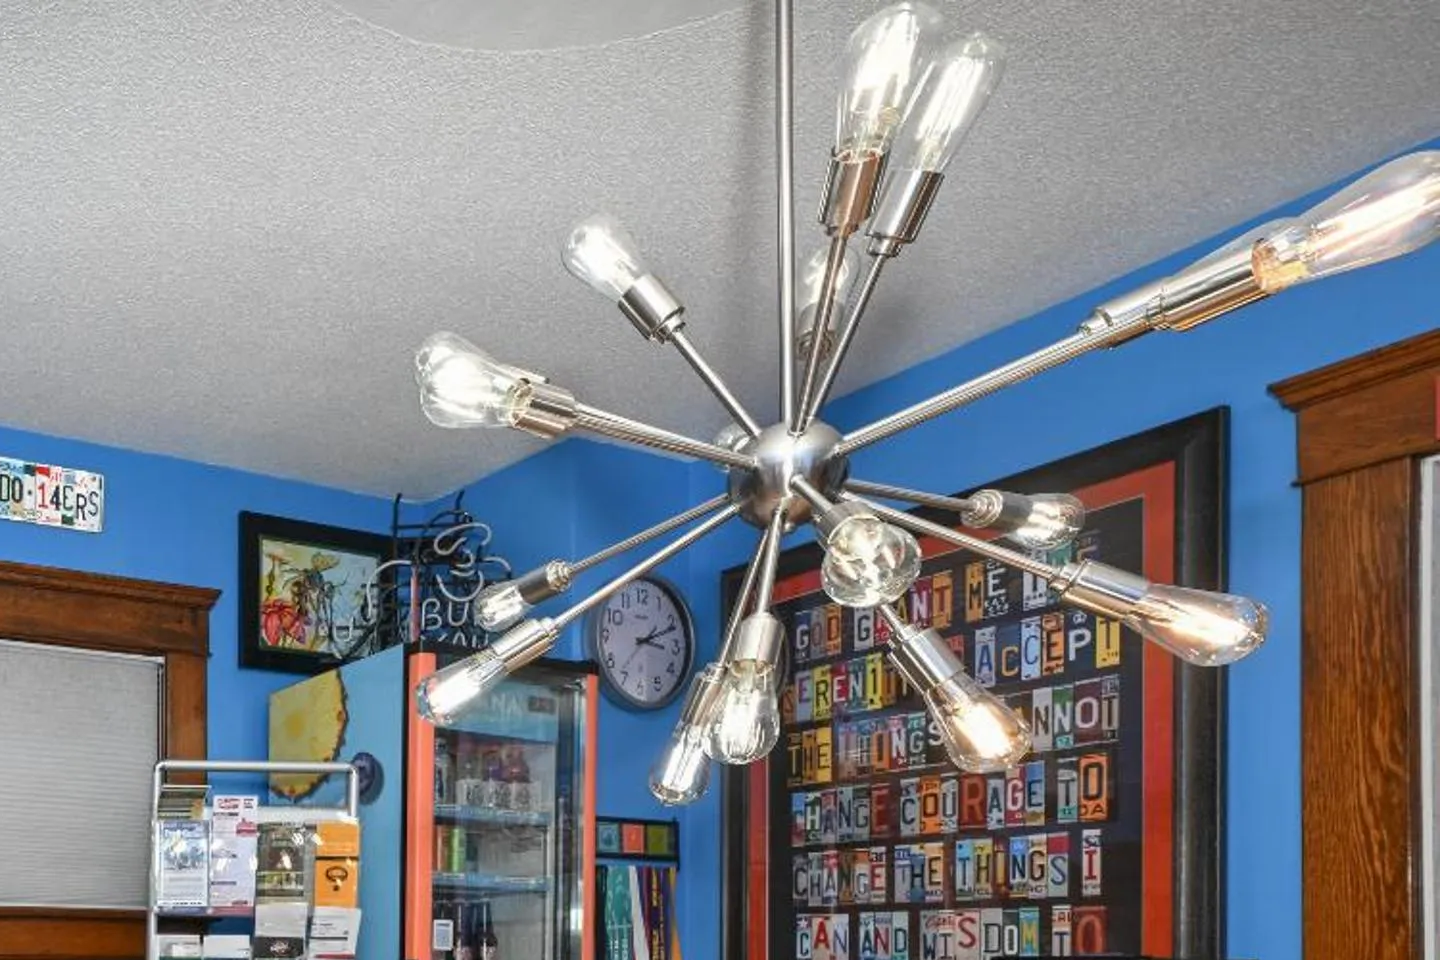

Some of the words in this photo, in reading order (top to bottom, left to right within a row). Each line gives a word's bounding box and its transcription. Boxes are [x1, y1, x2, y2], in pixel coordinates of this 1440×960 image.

[38, 481, 99, 521] 14ERS
[607, 608, 622, 626] 10
[621, 592, 630, 609] 11
[636, 589, 648, 606] 12
[796, 613, 841, 651] GOD
[969, 568, 1006, 610] ME
[671, 639, 681, 656] 3
[978, 620, 1118, 677] ACCEPT
[788, 741, 831, 776] THE
[838, 717, 945, 768] THINGS
[903, 776, 1045, 825] COURAGE
[1058, 761, 1105, 808] TO
[795, 861, 884, 897] CHANGE
[898, 856, 942, 890] THE
[958, 850, 1066, 887] THINGS
[799, 917, 848, 957] CAN
[862, 927, 907, 956] AND
[922, 916, 1039, 960] WISDOM
[1053, 913, 1104, 957] TO
